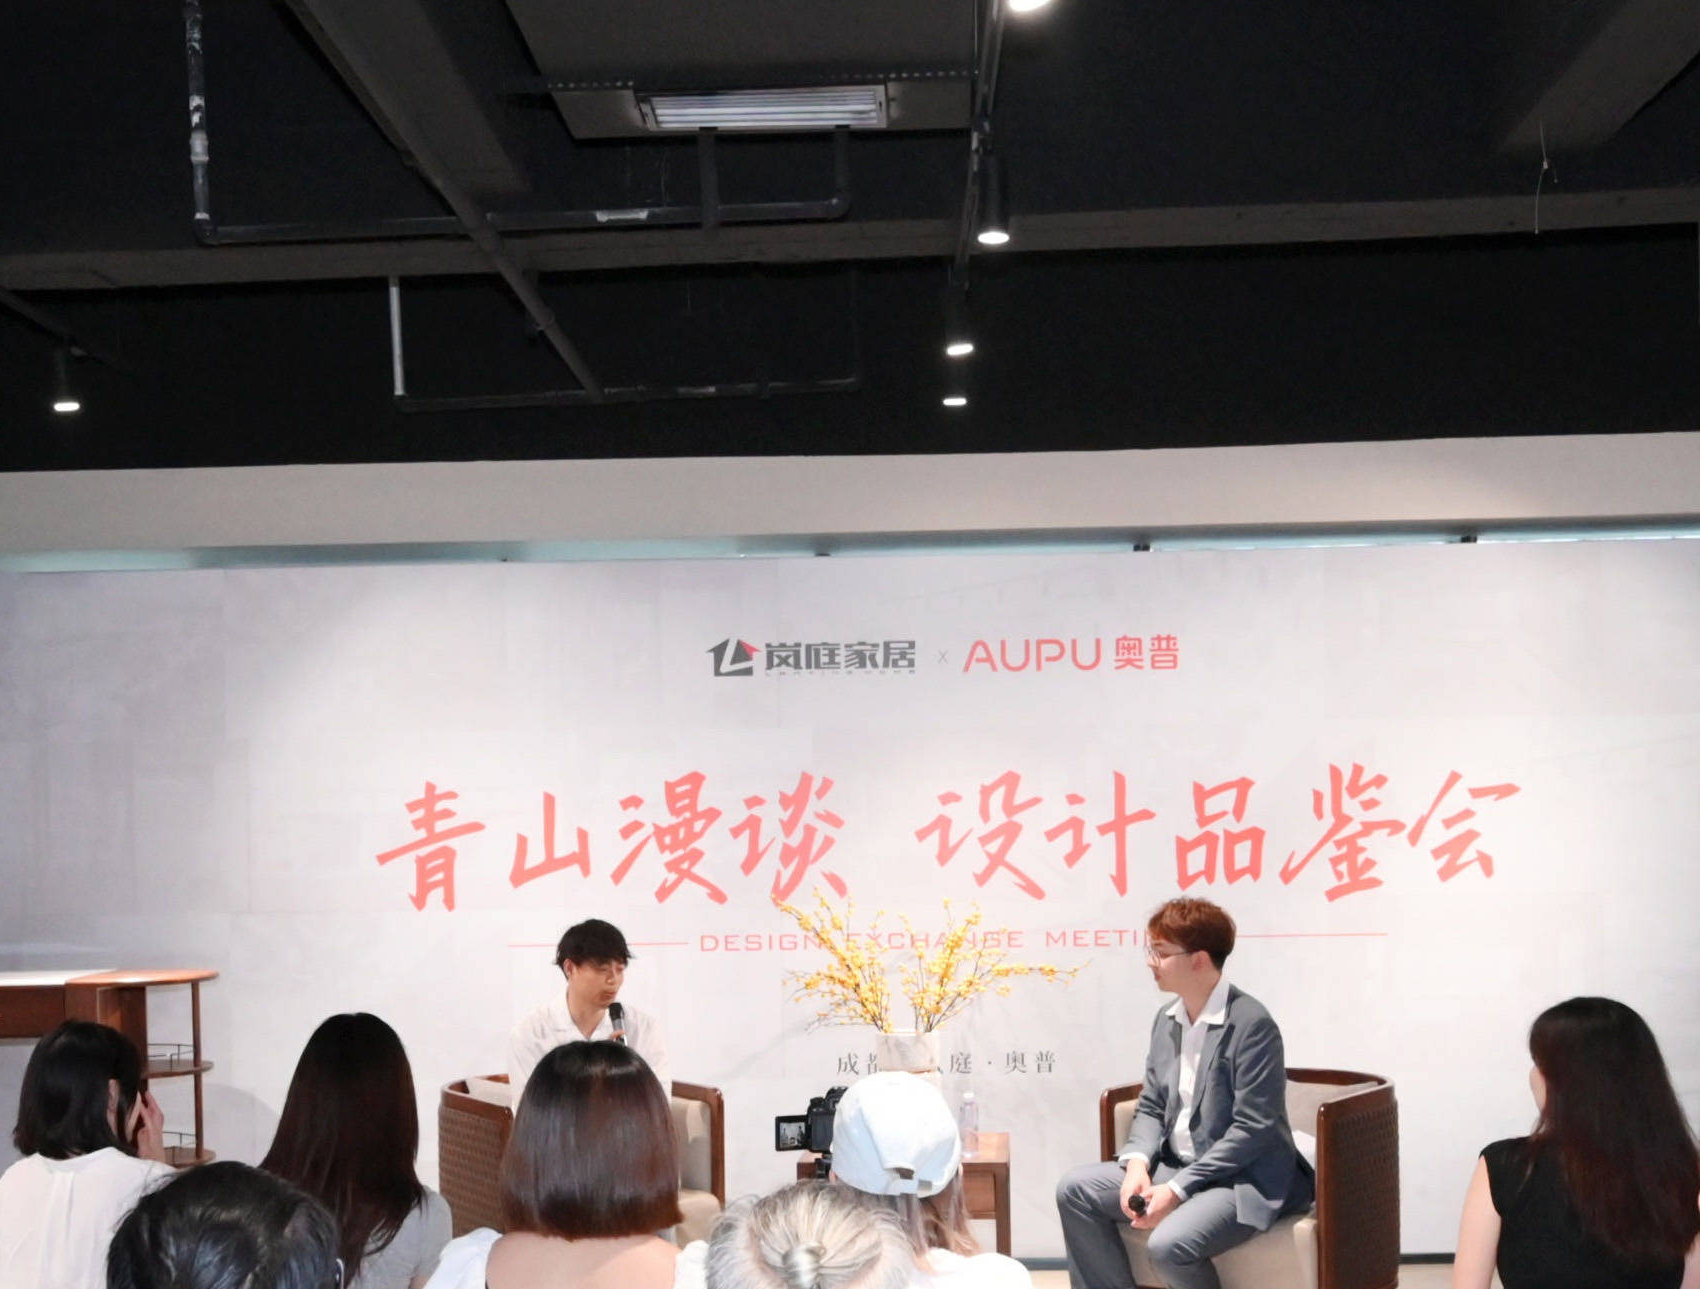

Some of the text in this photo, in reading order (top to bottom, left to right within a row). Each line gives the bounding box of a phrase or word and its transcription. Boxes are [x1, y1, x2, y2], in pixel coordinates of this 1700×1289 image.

[764, 639, 916, 671] 岚庭家居
[963, 637, 1101, 672] AUPU
[1114, 634, 1180, 671] 奥普
[377, 762, 1522, 912] 青山漫谈 设计品鉴会
[700, 932, 826, 952] DESIGN
